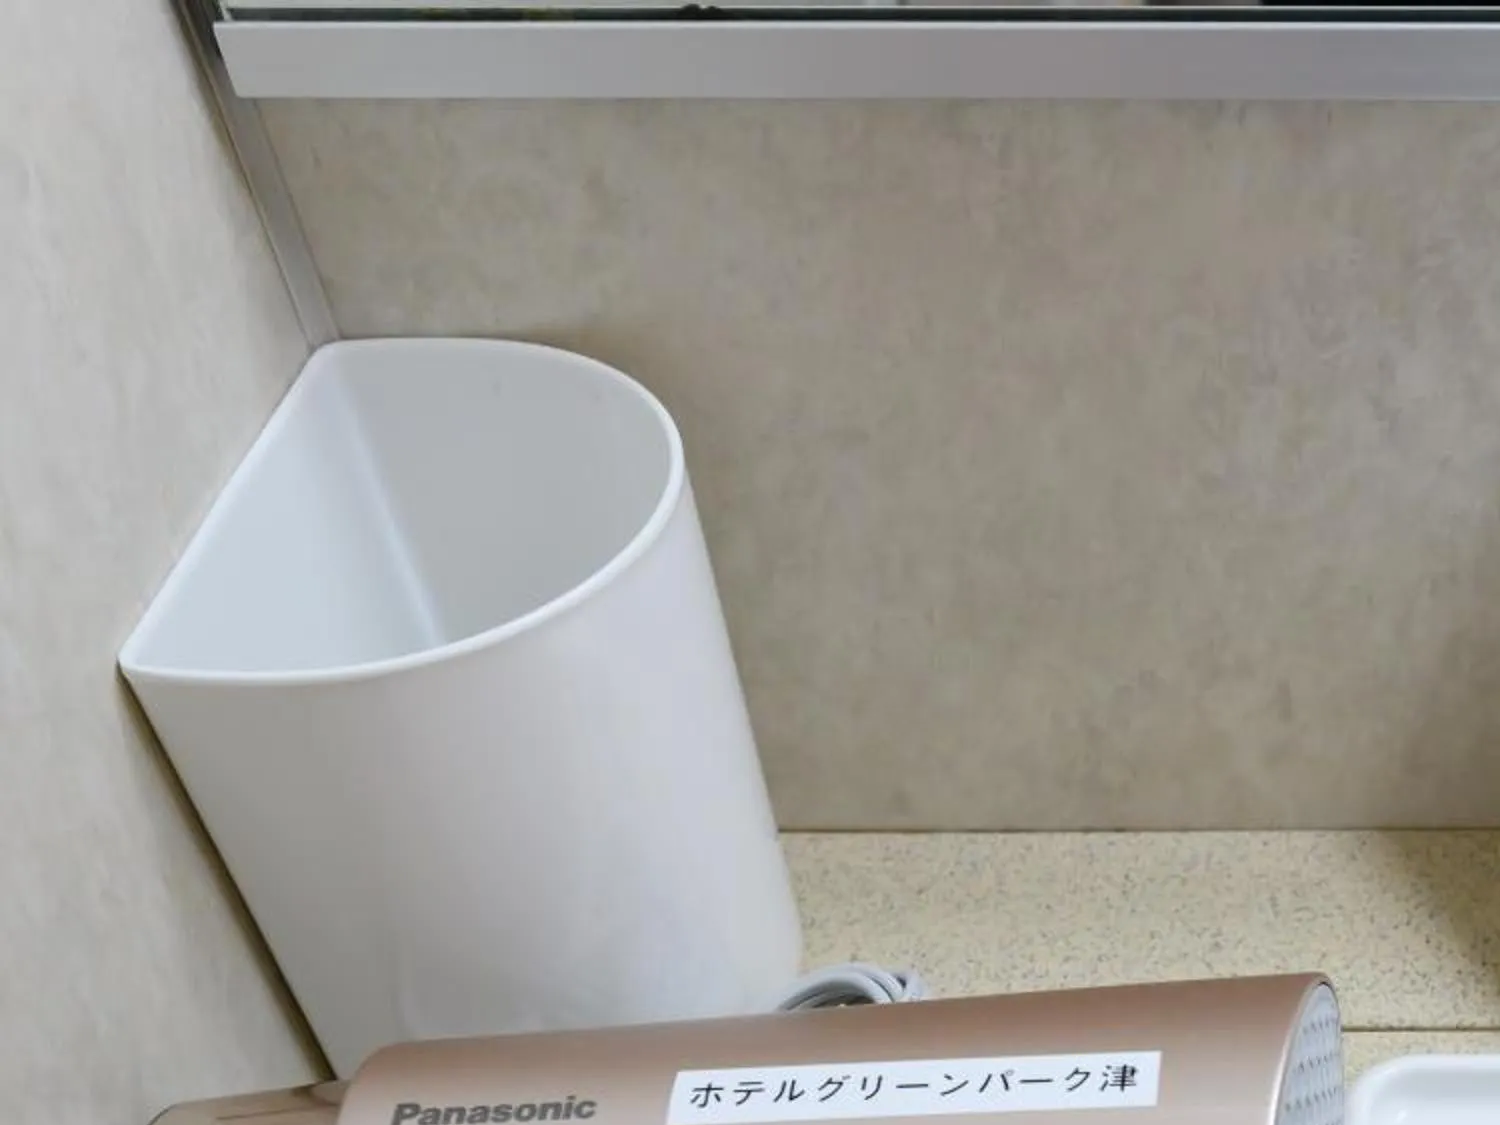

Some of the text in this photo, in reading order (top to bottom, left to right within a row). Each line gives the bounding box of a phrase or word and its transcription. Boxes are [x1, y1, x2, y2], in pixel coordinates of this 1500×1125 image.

[690, 1063, 1137, 1109] ホテルグリーンパーク津
